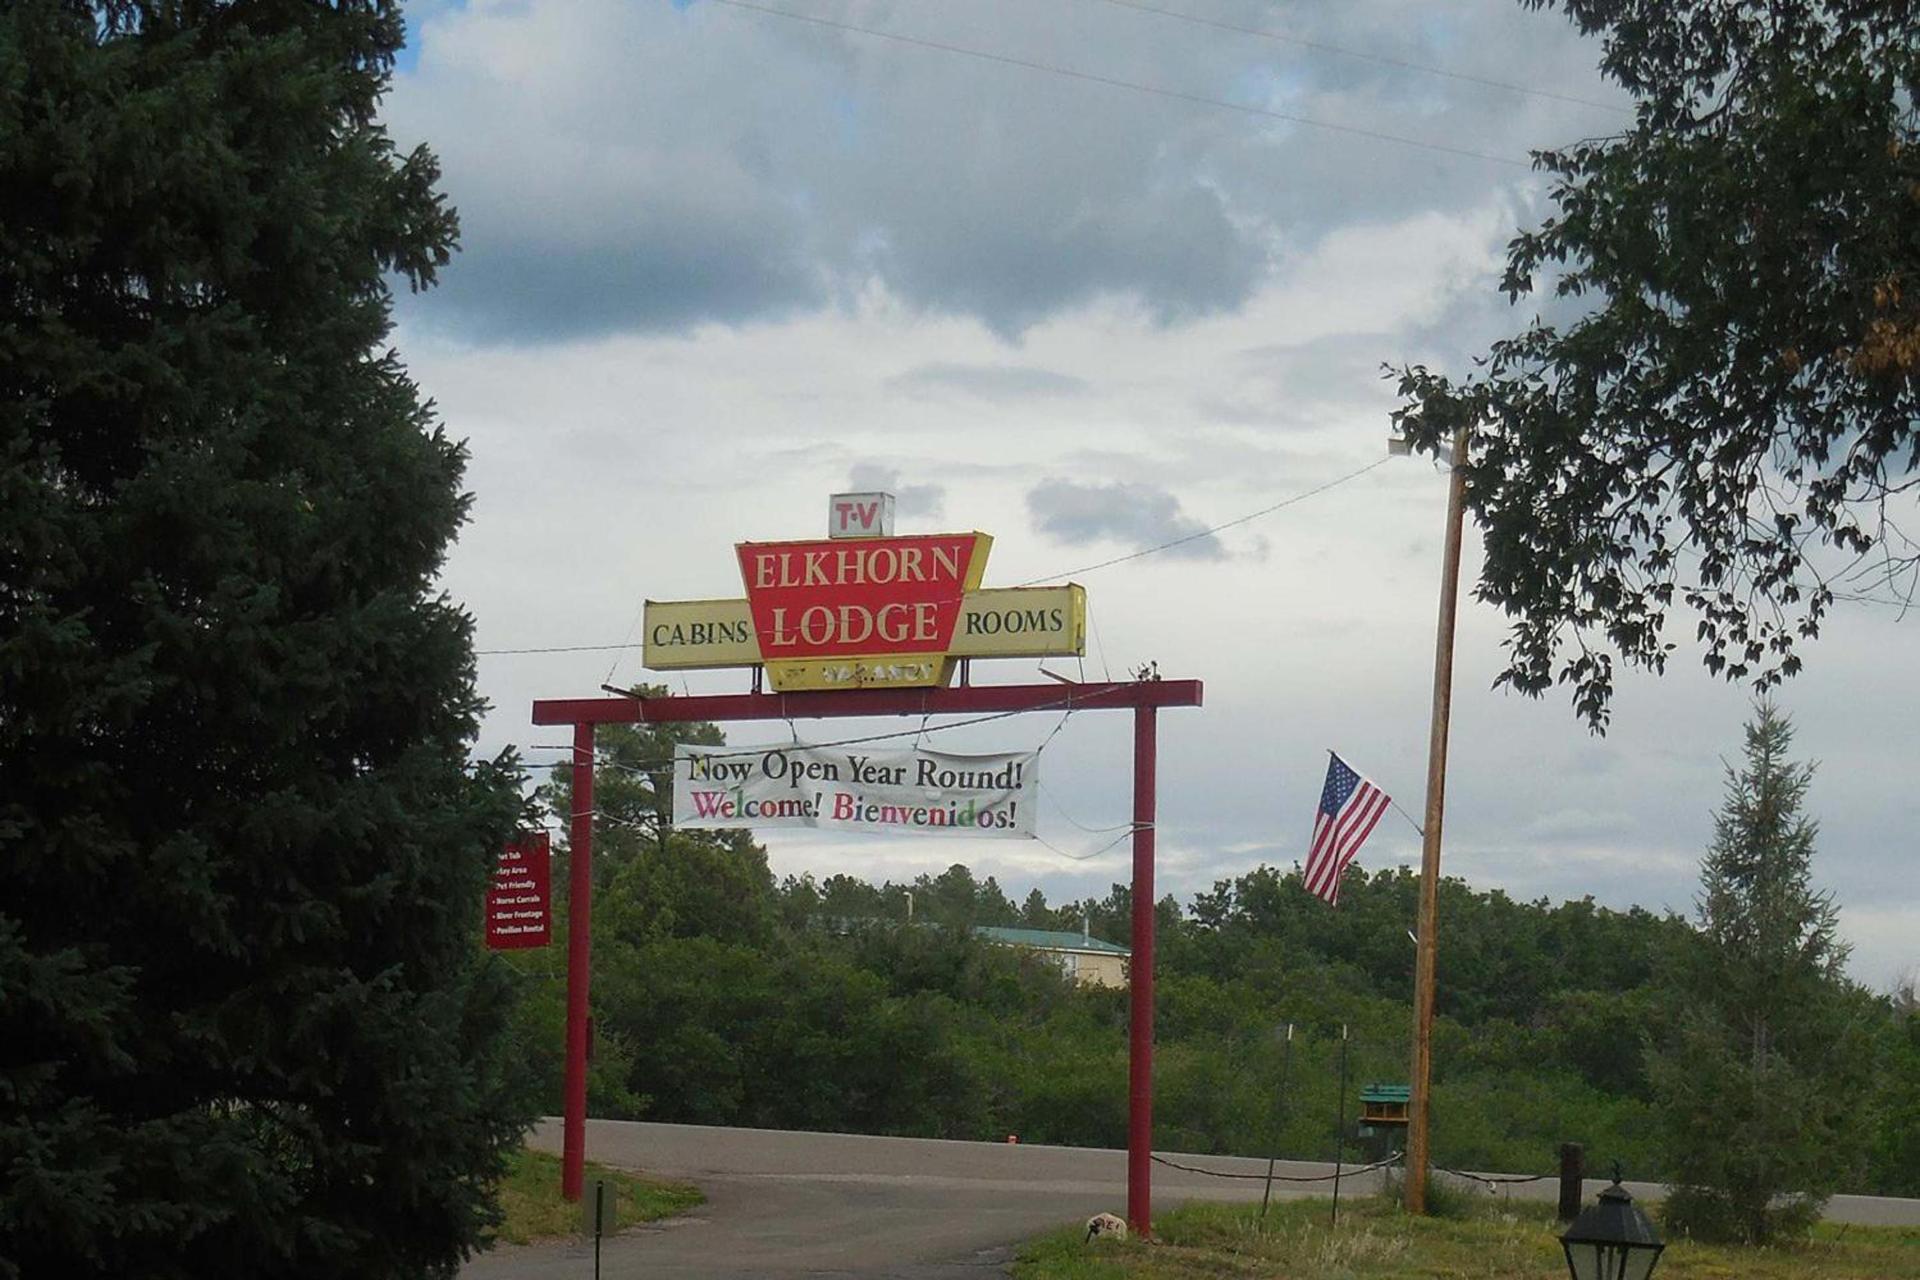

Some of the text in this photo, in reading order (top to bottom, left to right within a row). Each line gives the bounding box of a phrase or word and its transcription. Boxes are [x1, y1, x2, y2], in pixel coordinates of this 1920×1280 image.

[754, 545, 960, 589] ELKHORN
[652, 620, 749, 647] CABINS
[771, 602, 939, 648] LODGE
[965, 607, 1064, 635] ROOMS
[688, 749, 1023, 791] Now Open Year Round!
[691, 789, 1017, 829] Welcome! Bienvenidos!
[509, 880, 536, 889] Friendly
